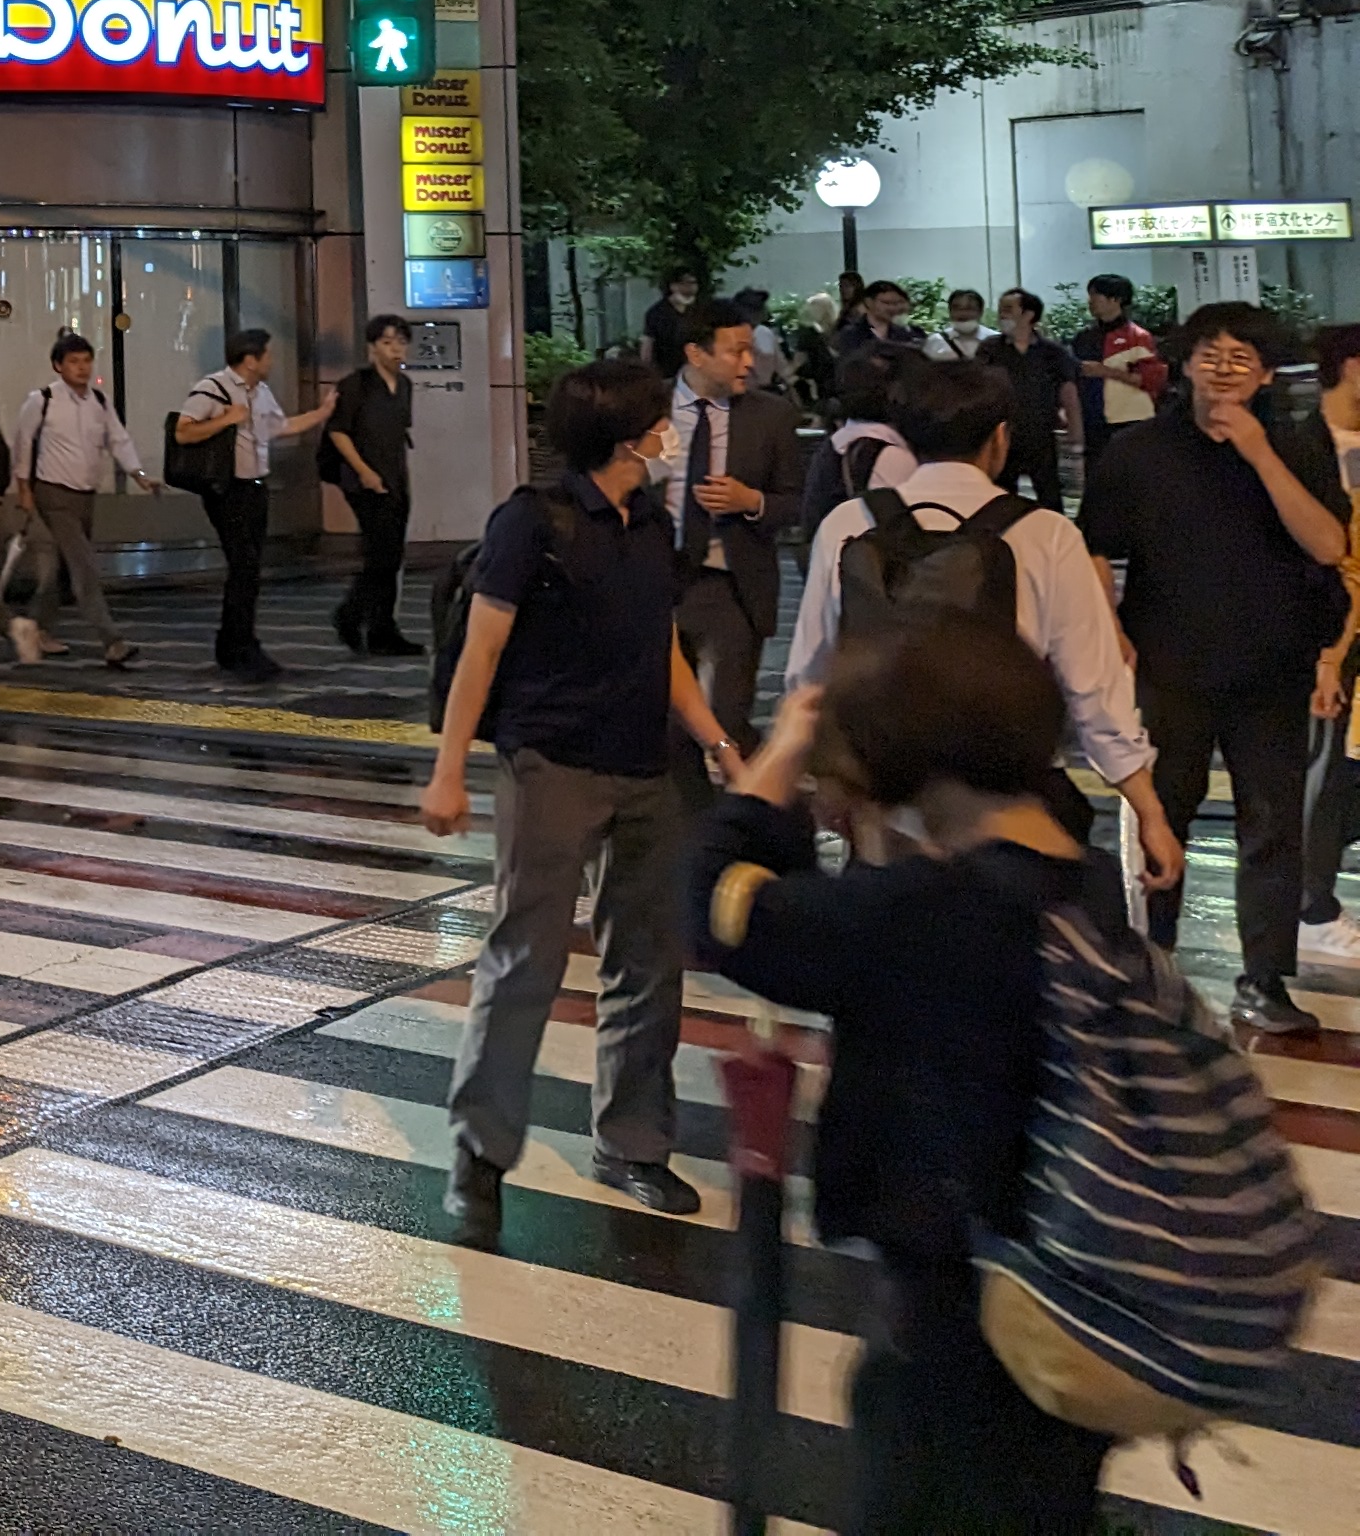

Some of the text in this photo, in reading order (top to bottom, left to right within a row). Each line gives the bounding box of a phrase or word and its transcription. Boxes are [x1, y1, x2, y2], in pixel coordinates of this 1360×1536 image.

[412, 92, 470, 107] Donut
[415, 140, 472, 154] Donut
[416, 188, 473, 202] Donut
[1254, 211, 1344, 227] 新宿文化センター
